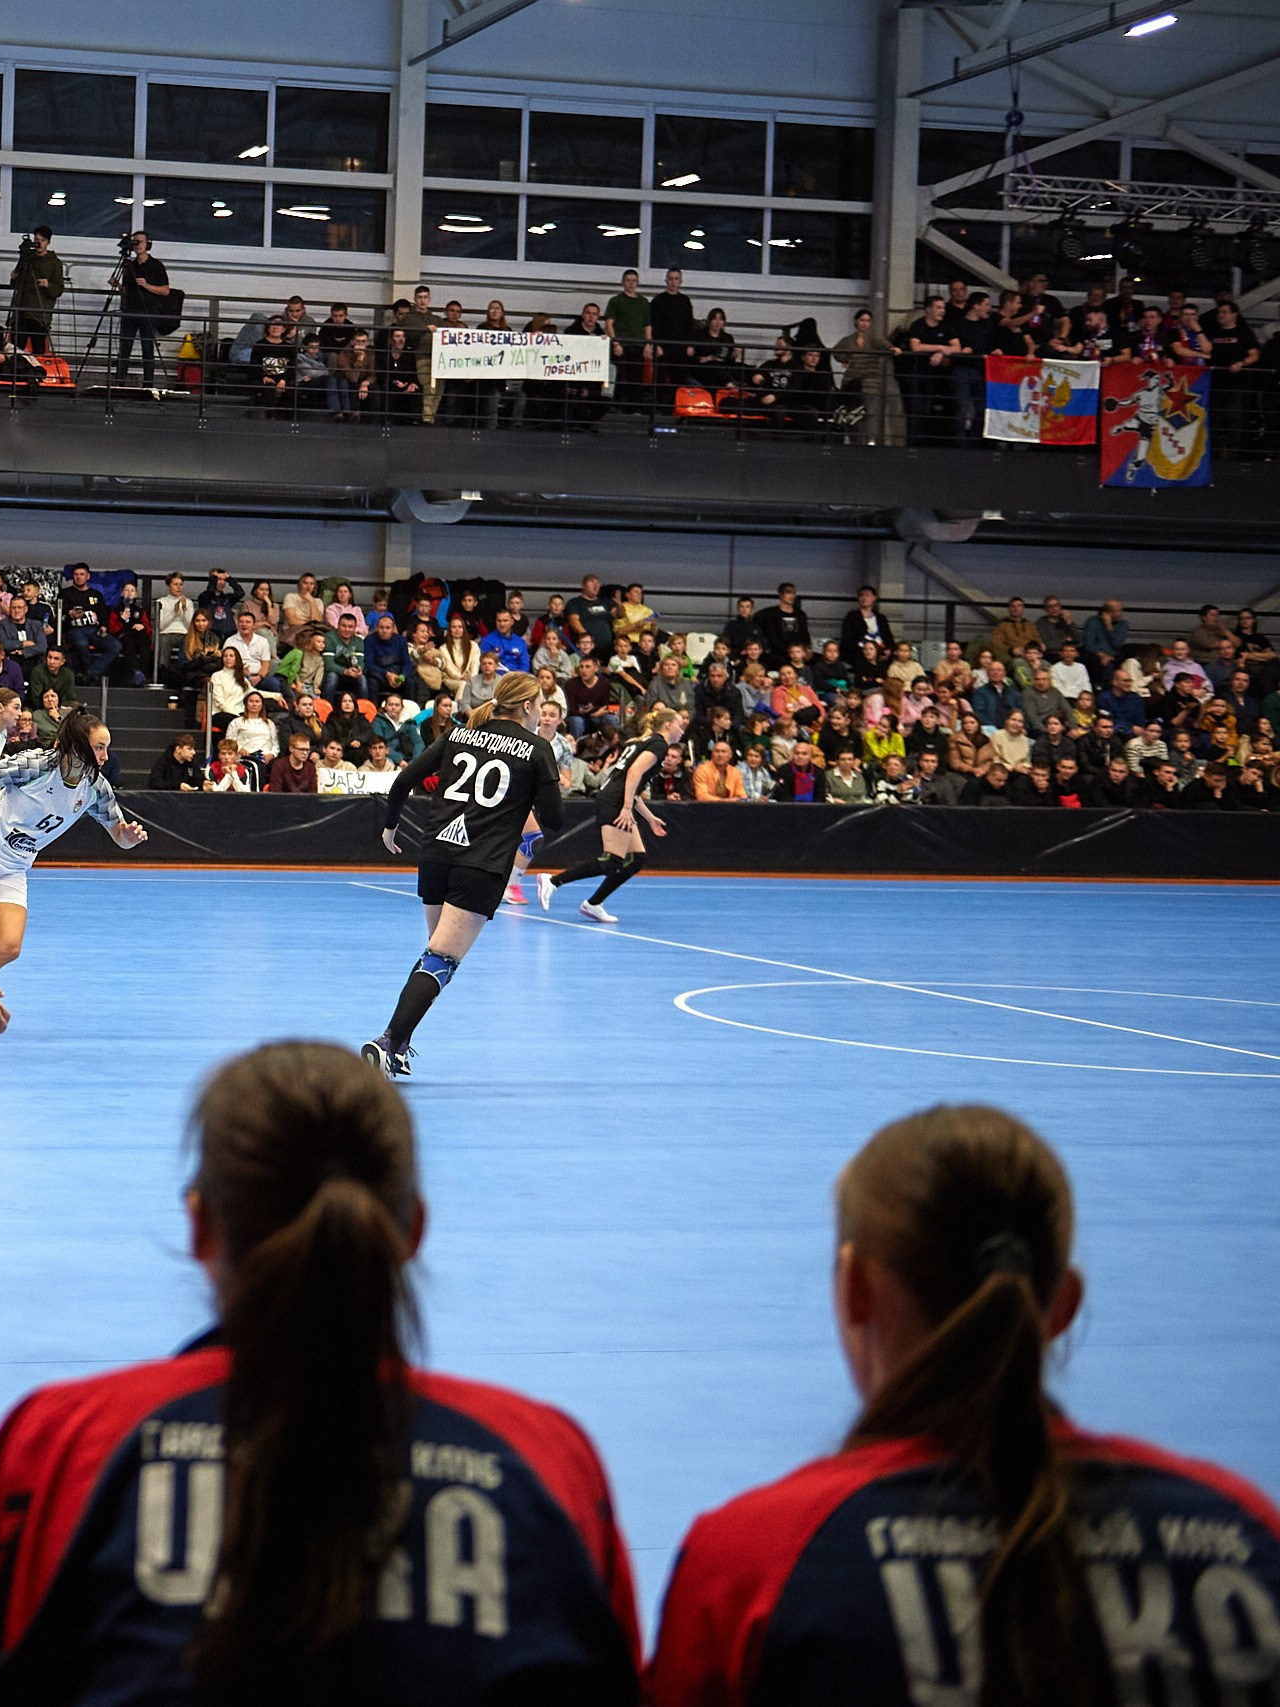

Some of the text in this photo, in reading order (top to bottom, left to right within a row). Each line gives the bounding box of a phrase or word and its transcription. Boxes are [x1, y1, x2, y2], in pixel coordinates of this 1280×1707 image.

[448, 726, 535, 761] МИНАБУТДИНОВА
[443, 751, 511, 808] 20
[35, 813, 65, 834] 67
